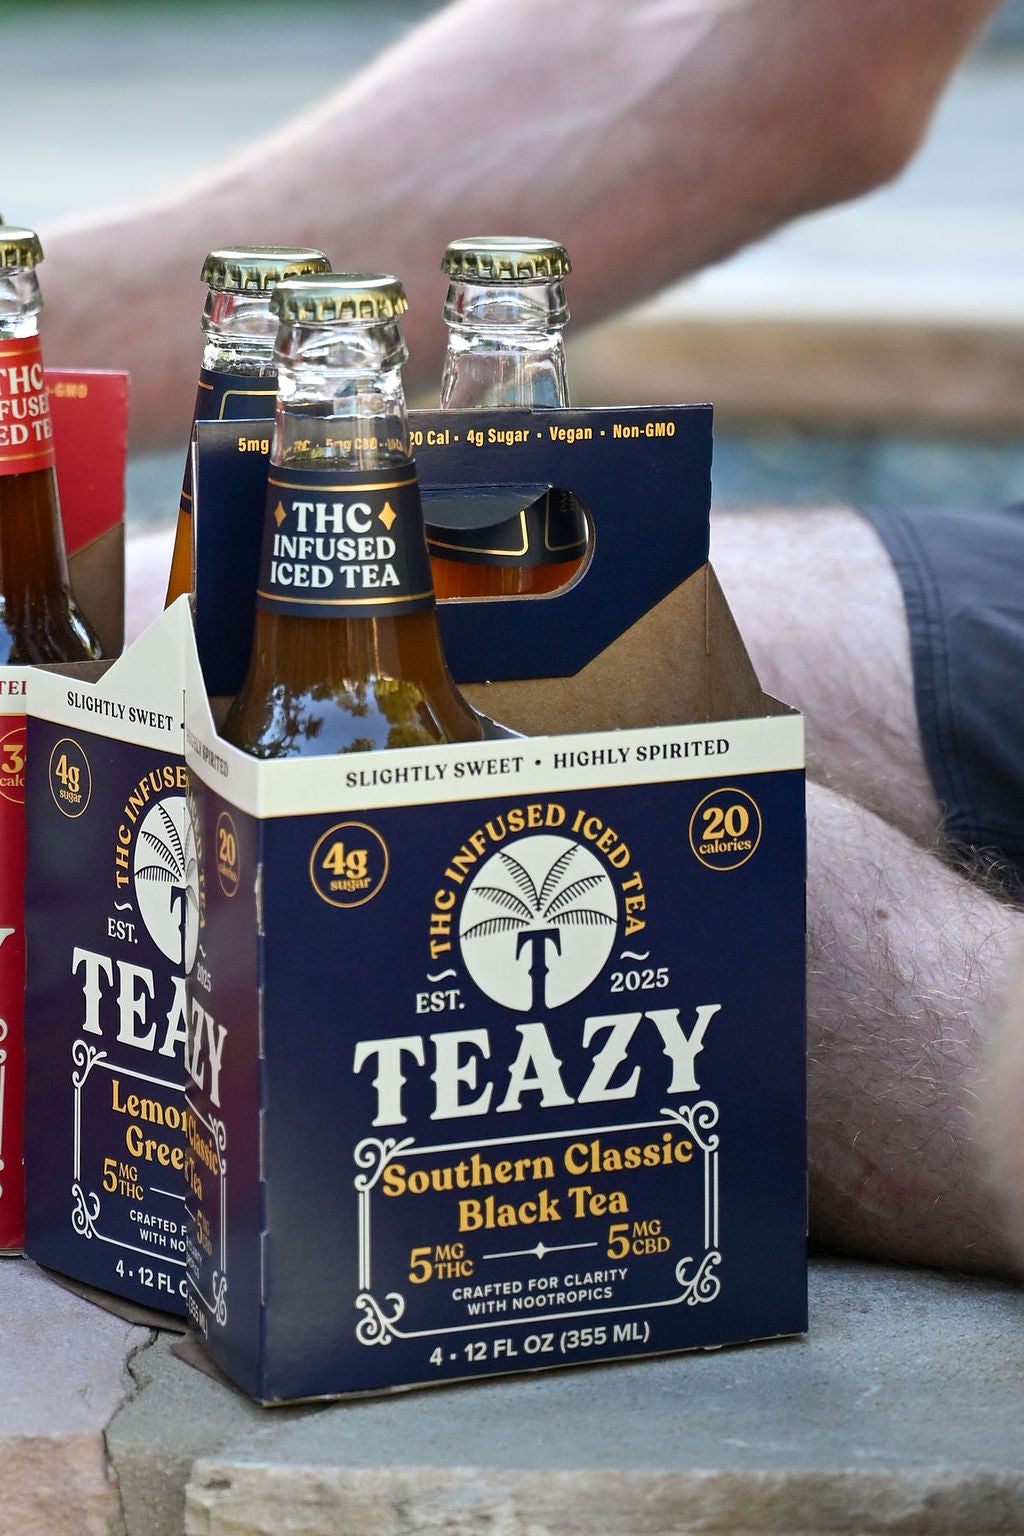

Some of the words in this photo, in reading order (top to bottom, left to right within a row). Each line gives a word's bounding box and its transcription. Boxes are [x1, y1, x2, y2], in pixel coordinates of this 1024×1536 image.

[238, 437, 269, 454] 5mg
[427, 430, 451, 446] Cal
[466, 429, 485, 448] 4g
[488, 427, 529, 447] Sugar
[549, 426, 592, 446] Vegan
[613, 422, 675, 439] Non-GMO
[292, 501, 373, 535] THC
[273, 537, 396, 562] INFUSED
[270, 564, 333, 589] ICED
[340, 562, 401, 589] TEA
[67, 691, 126, 720] SLIGHTLY
[129, 707, 173, 731] SWEET
[56, 754, 80, 793] 4g
[345, 765, 445, 789] SLIGHTLY
[454, 757, 524, 778] SWEET
[553, 748, 630, 769] HIGHLY
[636, 739, 730, 762] SPIRITED
[60, 788, 82, 804] sugar
[702, 805, 749, 841] 20
[116, 824, 132, 888] THC
[219, 828, 236, 866] 20
[323, 842, 368, 879] 4g
[699, 838, 751, 855] calories
[330, 875, 371, 892] sugar
[430, 890, 455, 959] THC
[445, 804, 566, 882] INFUSED
[571, 810, 629, 869] ICED
[621, 872, 647, 936] TEA
[107, 917, 138, 944] EST.
[415, 989, 465, 1015] EST.
[610, 968, 669, 993] 2025
[353, 1004, 722, 1126] TEAZY
[383, 1153, 554, 1197] Southern
[564, 1133, 693, 1176] Classic
[129, 1209, 178, 1234] CRAFTED
[458, 1190, 560, 1232] Black
[569, 1186, 629, 1219] Tea
[139, 1228, 166, 1247] WITH
[138, 1267, 153, 1287] 12
[158, 1272, 175, 1295] FL
[452, 1281, 522, 1302] CRAFTED
[528, 1276, 559, 1292] FOR
[564, 1268, 628, 1287] CLARITY
[467, 1299, 507, 1315] WITH
[511, 1287, 613, 1311] NOOTROPICS
[464, 1343, 487, 1362] 12
[493, 1339, 519, 1359] FL
[523, 1334, 554, 1355] OZ
[560, 1327, 608, 1356] (355
[613, 1322, 650, 1344] ML)
